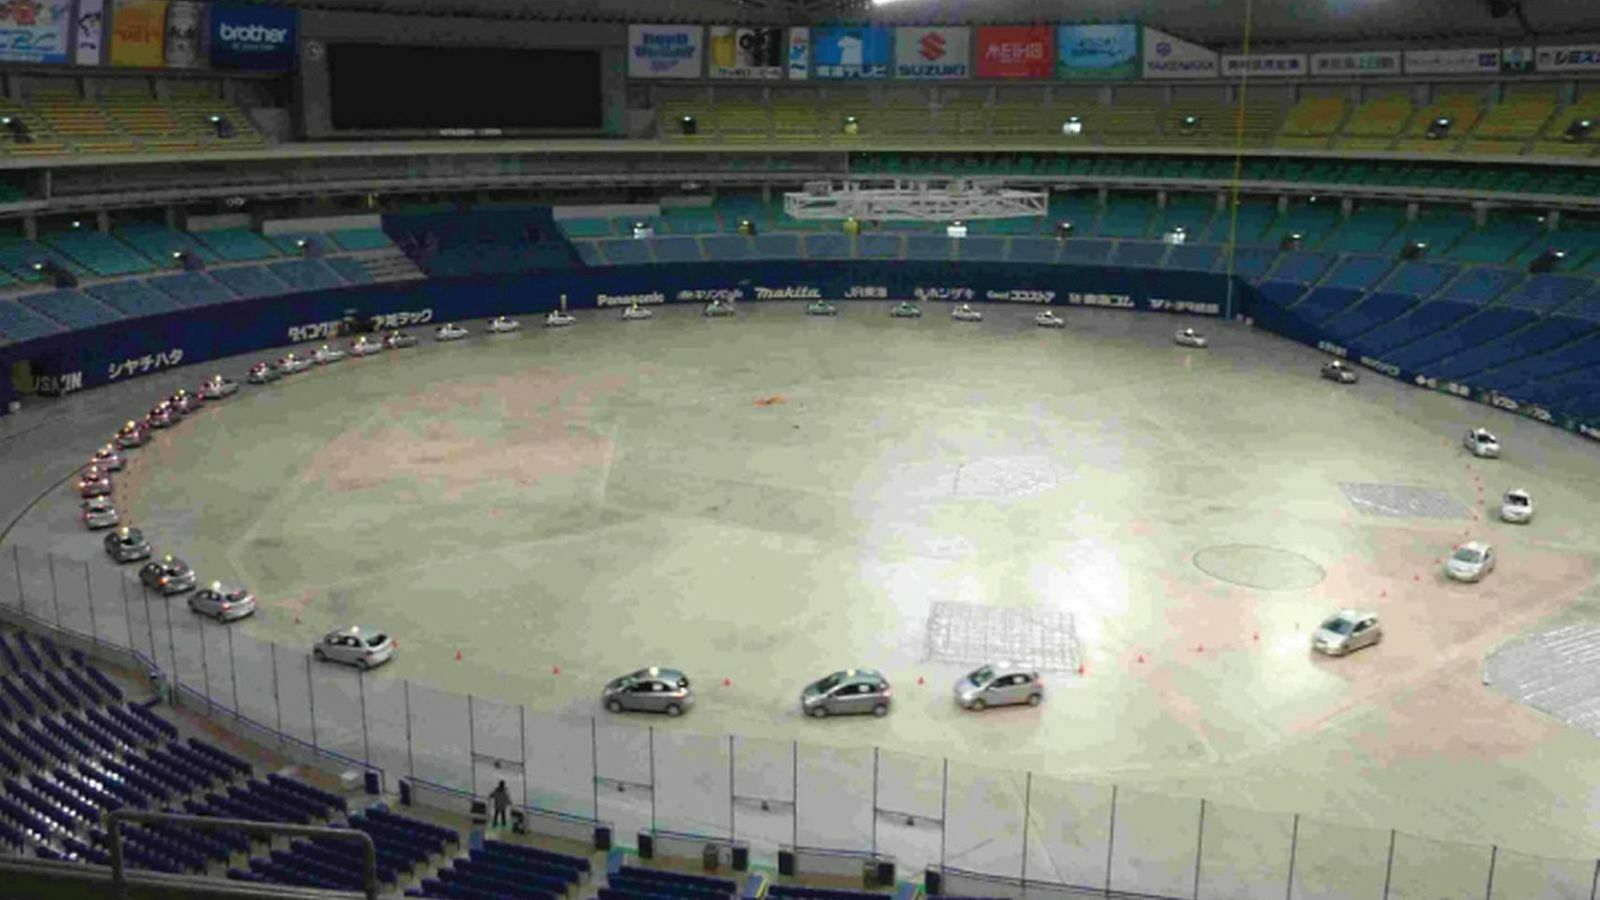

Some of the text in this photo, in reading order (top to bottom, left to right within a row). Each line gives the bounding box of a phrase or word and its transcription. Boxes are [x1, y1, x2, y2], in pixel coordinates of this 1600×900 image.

[219, 22, 288, 43] brother
[900, 65, 965, 77] SUZUKI
[597, 290, 665, 306] Panasonic
[108, 348, 184, 379] シヤチハタ
